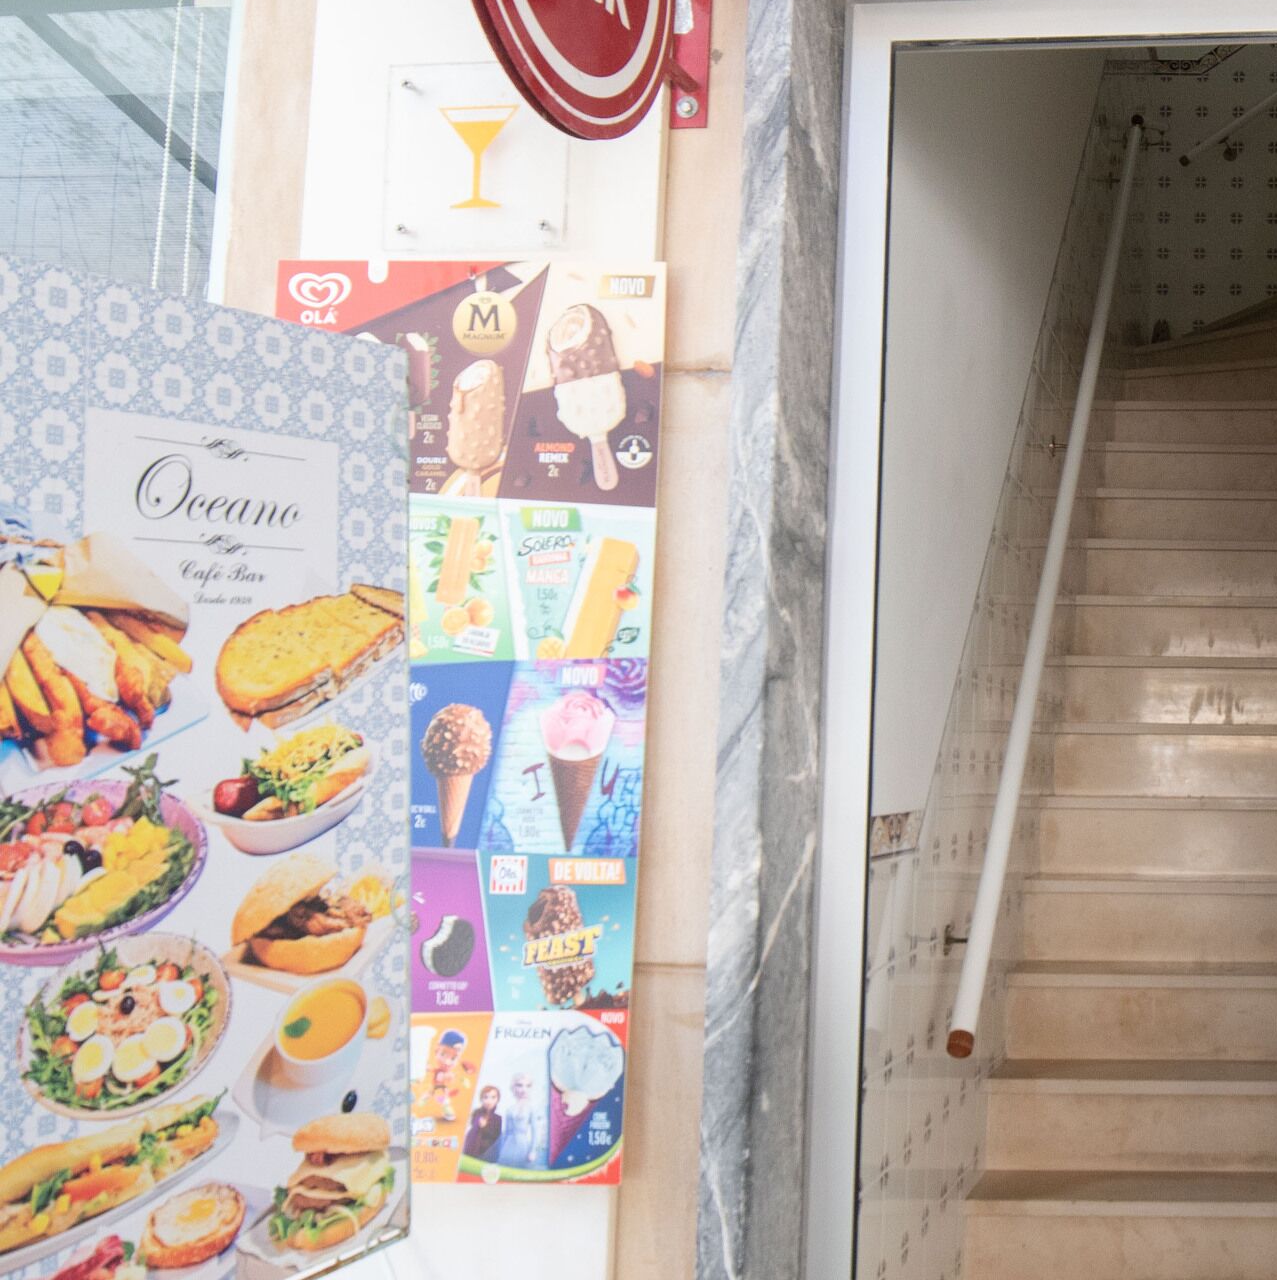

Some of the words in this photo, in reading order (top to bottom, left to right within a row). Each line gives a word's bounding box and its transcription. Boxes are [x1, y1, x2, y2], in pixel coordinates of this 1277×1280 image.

[609, 277, 646, 296] NOVO
[300, 306, 336, 325] OLÁ
[463, 330, 506, 342] MAGNUM
[534, 441, 576, 453] ALMOND
[416, 456, 448, 465] DOUBLE
[538, 453, 569, 464] REMIX
[135, 453, 301, 529] Oceano
[532, 509, 569, 528] NOVO
[517, 534, 574, 557] SOLERO
[178, 558, 222, 588] Café
[227, 563, 268, 583] Bar
[193, 590, 227, 605] Desde
[561, 667, 599, 686] NOVO
[553, 861, 571, 881] DE
[574, 861, 622, 881] VOLTA!
[524, 926, 601, 965] FEAST
[494, 1026, 551, 1040] FROZEN
